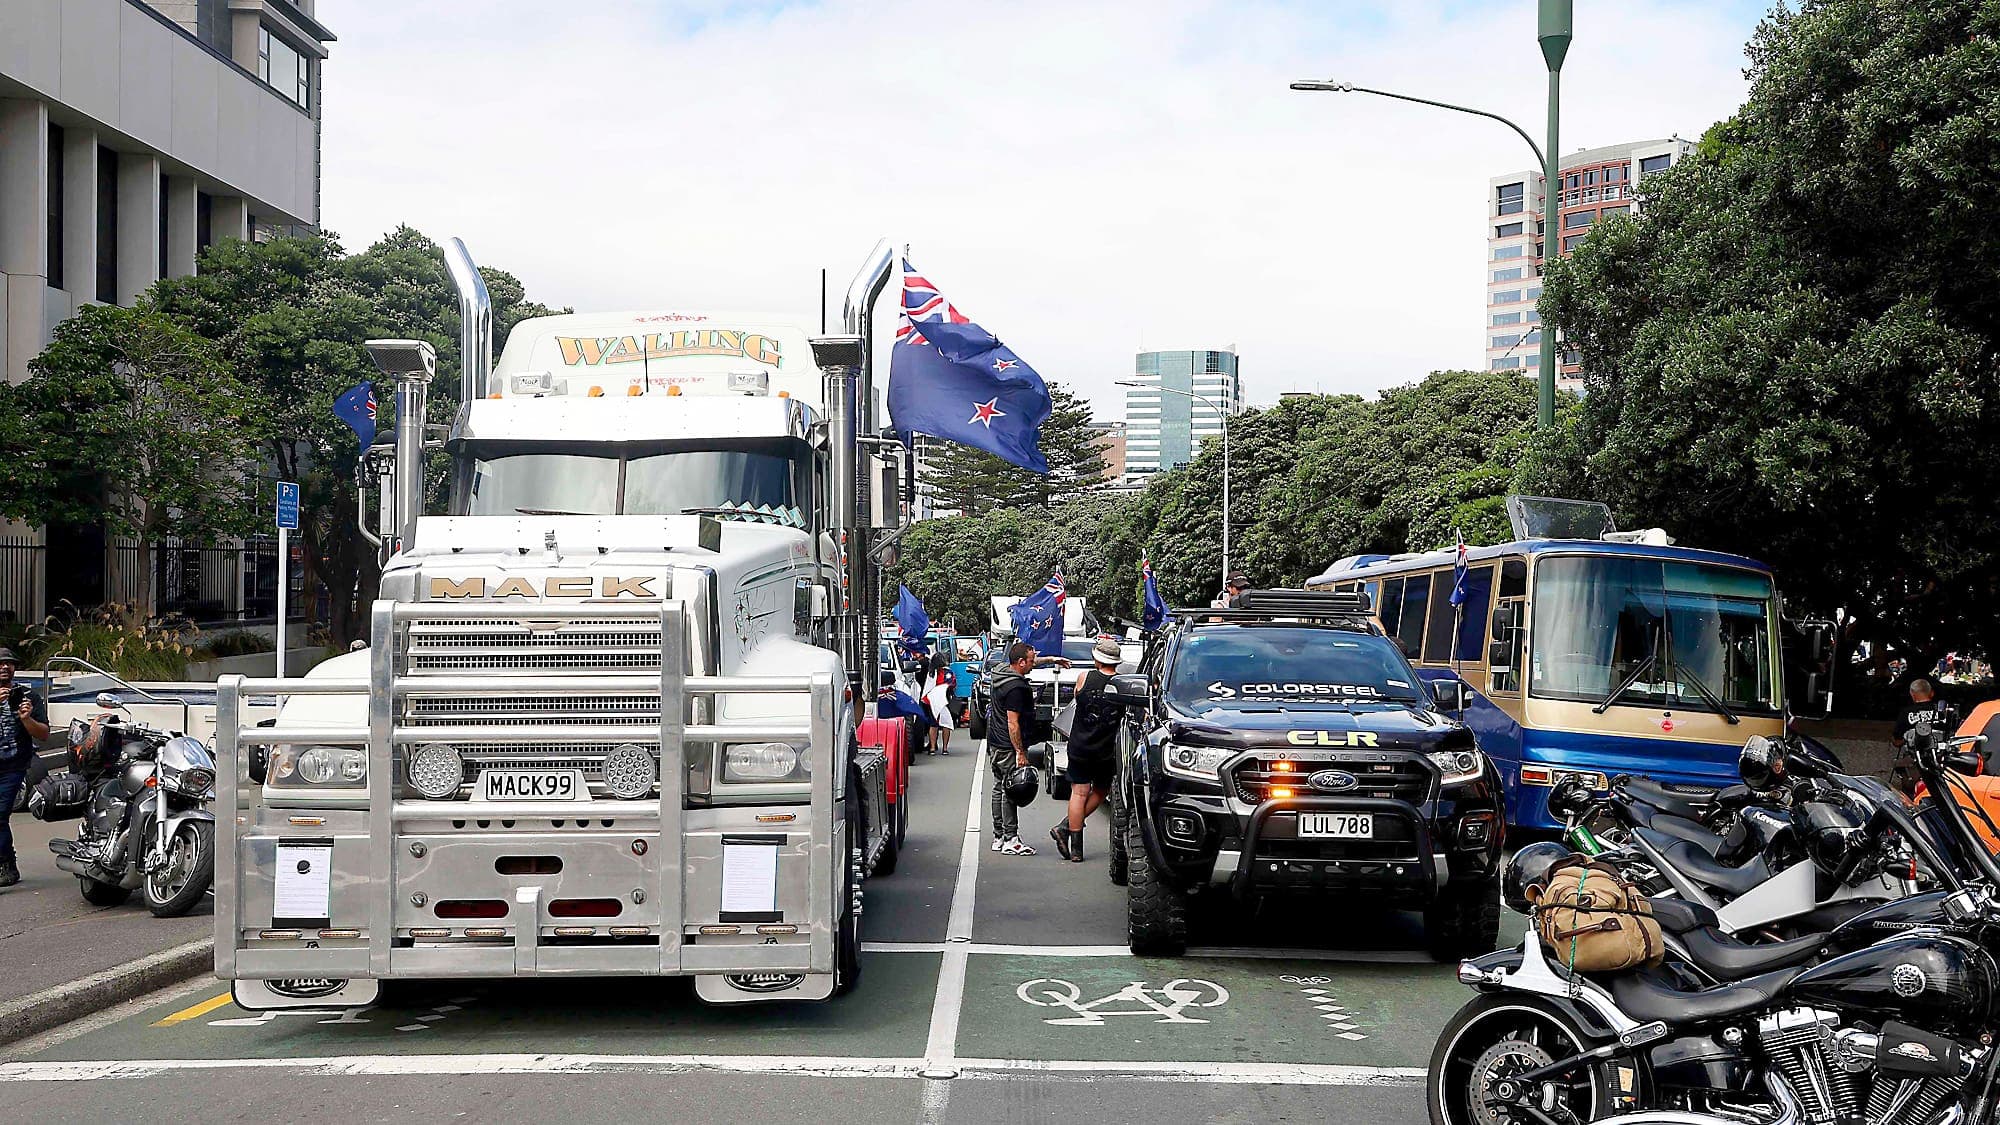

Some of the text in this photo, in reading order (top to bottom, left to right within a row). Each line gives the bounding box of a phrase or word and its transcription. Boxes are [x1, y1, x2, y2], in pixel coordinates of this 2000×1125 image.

[555, 329, 782, 369] WALLING
[430, 577, 657, 598] MACK
[1241, 683, 1383, 697] COLORSTEEL
[1286, 730, 1380, 748] CLR
[490, 775, 571, 796] MACK99
[1321, 775, 1346, 786] Ford
[1302, 817, 1370, 834] LUL708
